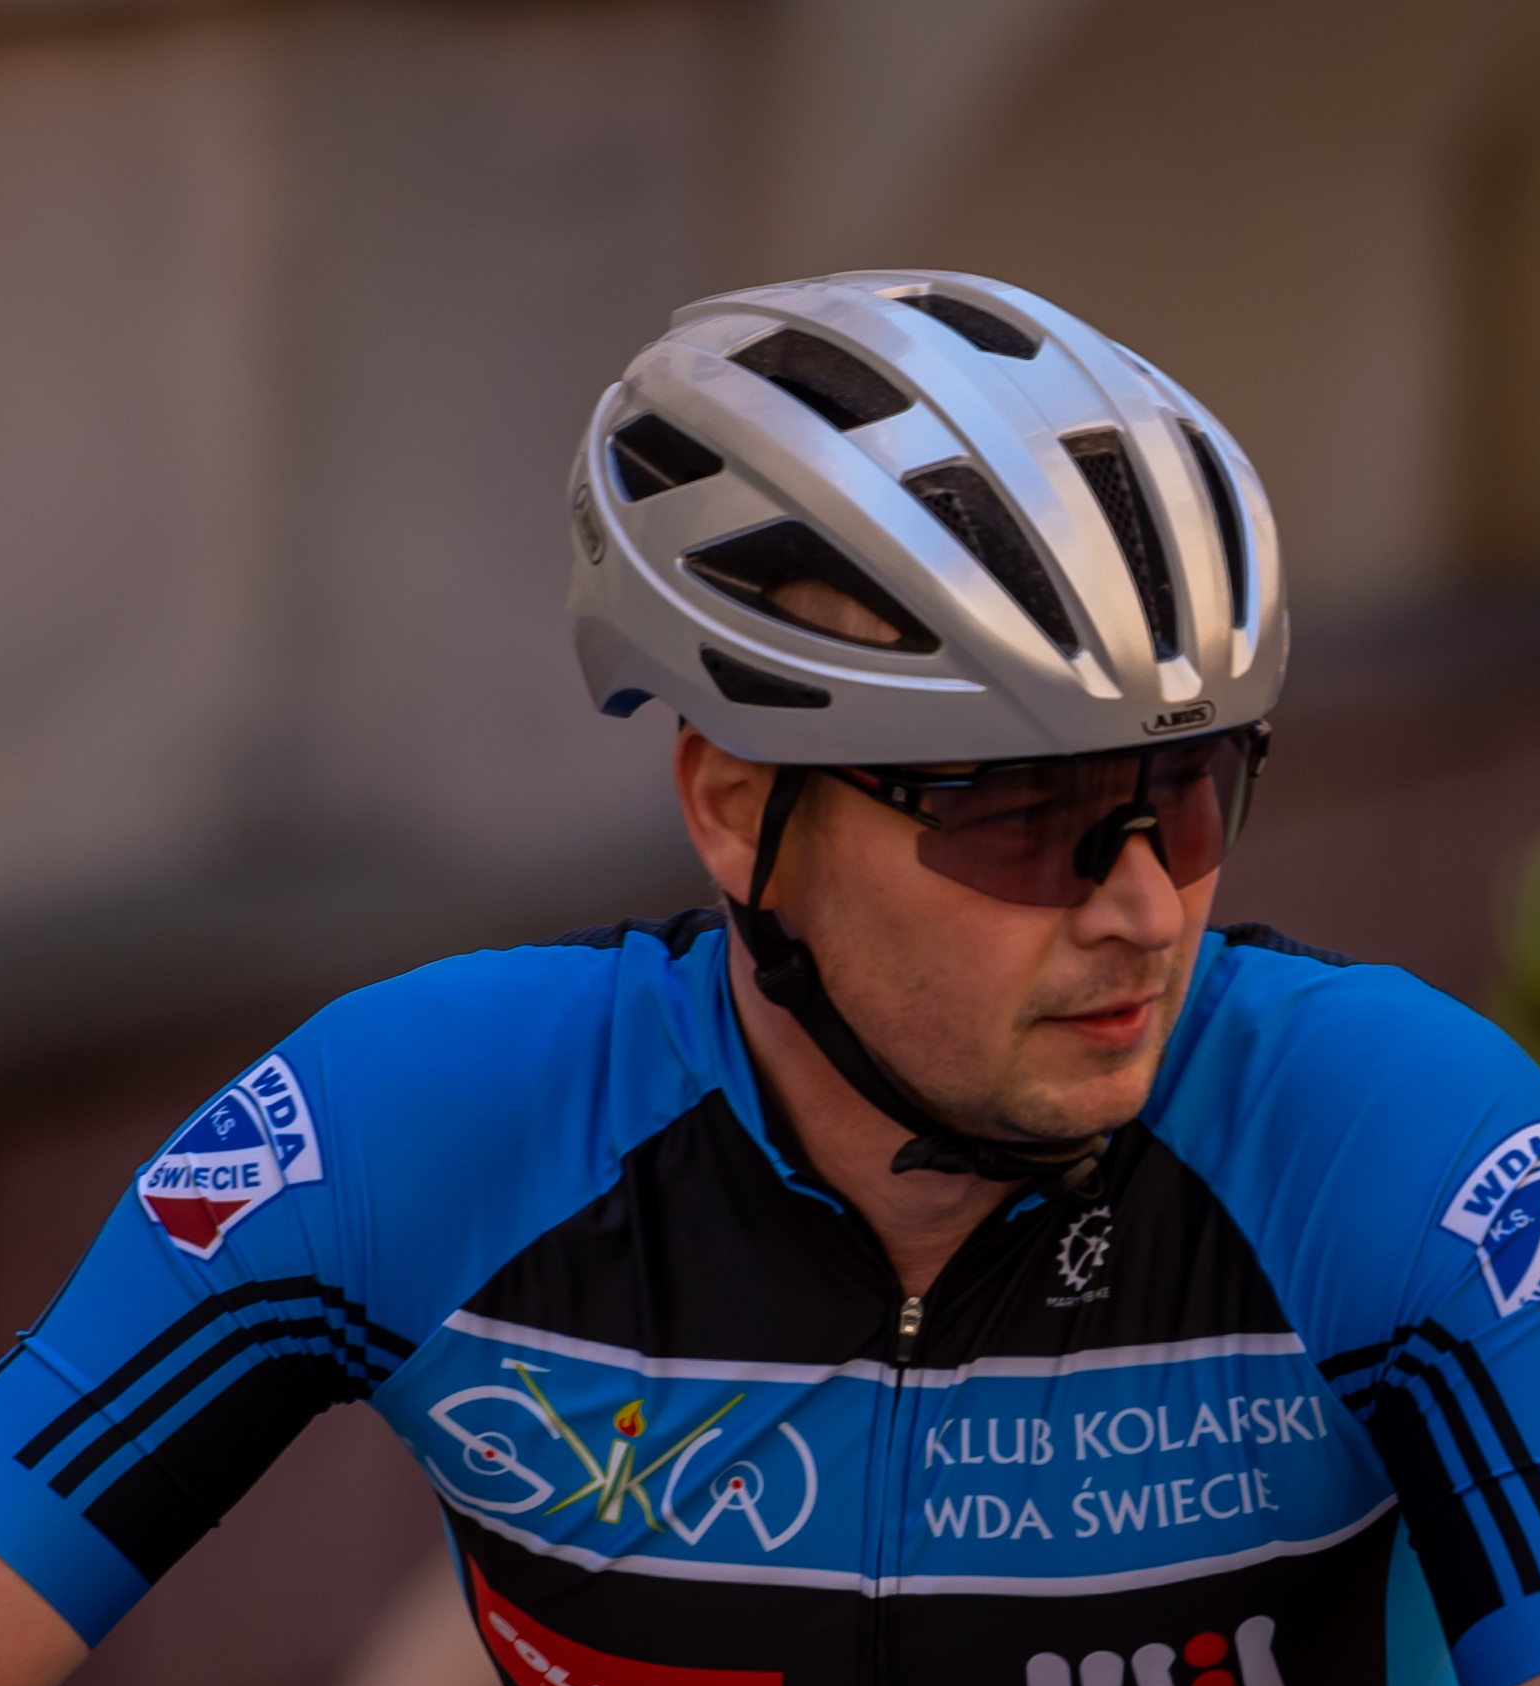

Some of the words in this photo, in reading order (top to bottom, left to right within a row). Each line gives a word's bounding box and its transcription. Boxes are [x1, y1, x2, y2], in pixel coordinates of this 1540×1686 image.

[1153, 706, 1207, 729] ABUS
[252, 1066, 306, 1172] WDA
[147, 1161, 262, 1191] ŚWIECIE
[924, 1417, 1054, 1469] KLUB
[924, 1494, 1054, 1540] WDA
[1071, 1468, 1279, 1539] ŚWIECIE
